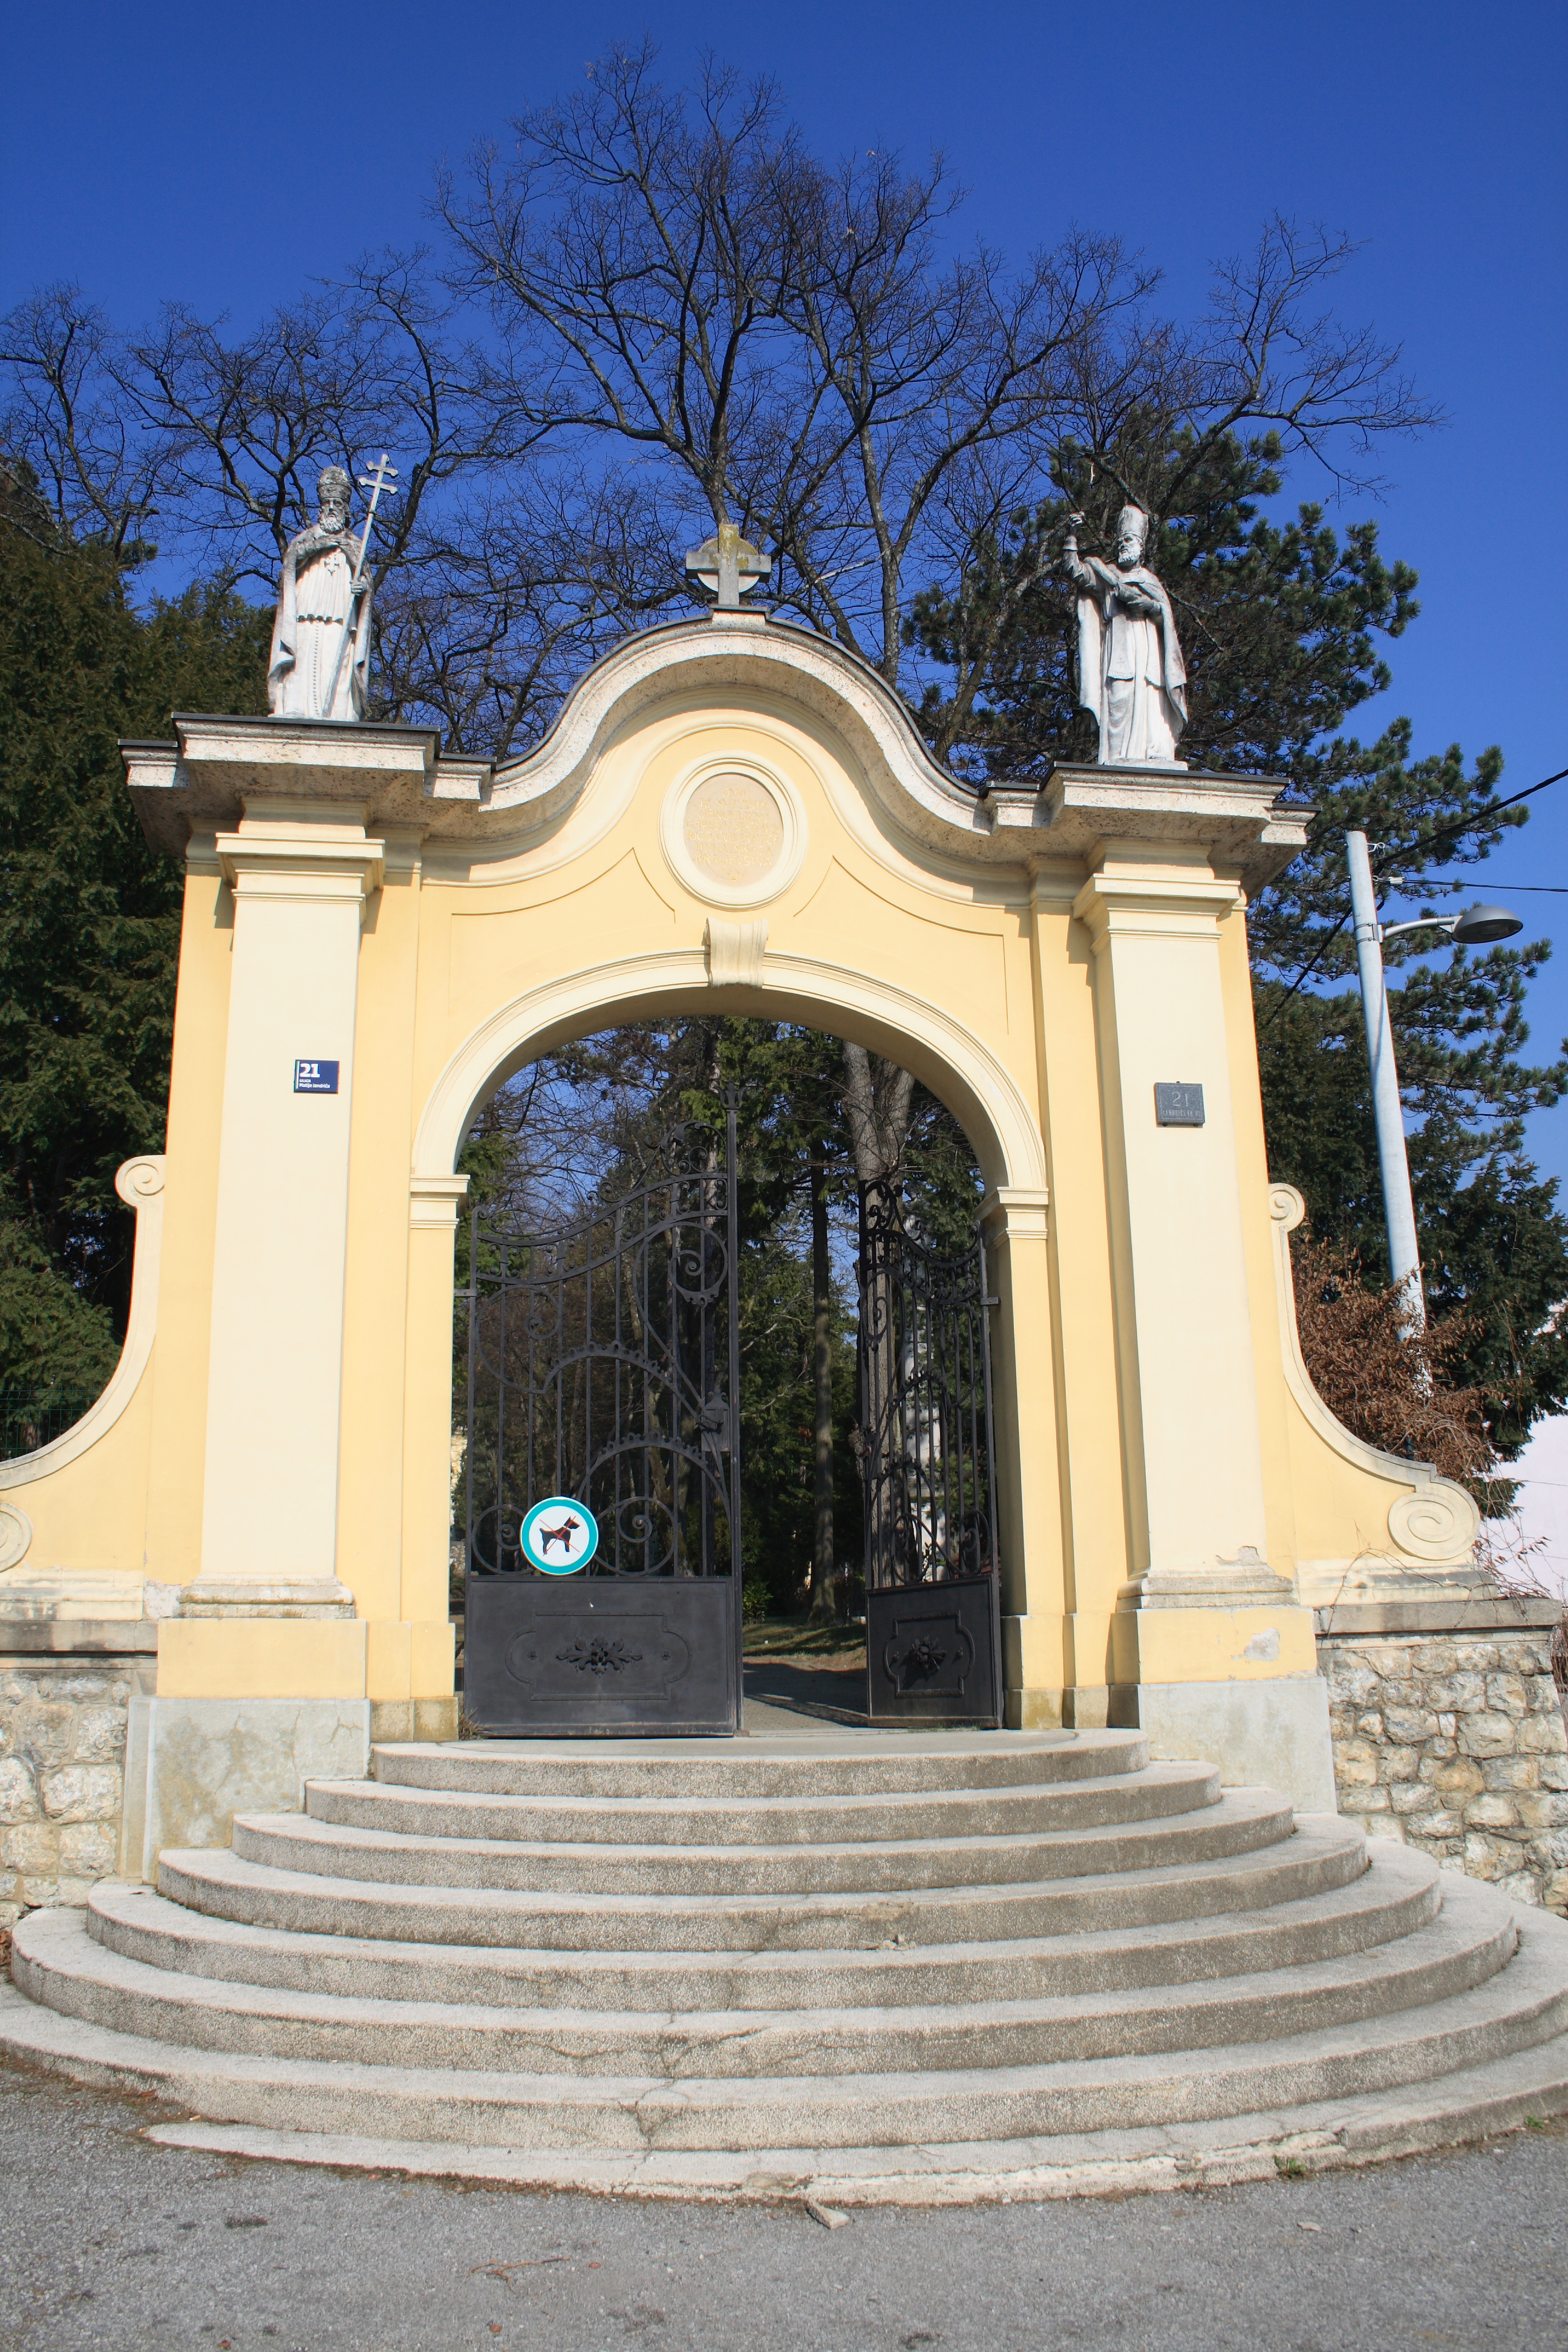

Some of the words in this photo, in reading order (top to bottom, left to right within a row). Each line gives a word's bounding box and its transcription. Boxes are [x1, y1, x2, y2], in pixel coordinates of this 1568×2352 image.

[722, 788, 745, 799] OVO
[698, 797, 711, 808] JE
[695, 842, 774, 856] HRVATSKOGA
[299, 1063, 321, 1078] 21
[1171, 1091, 1189, 1107] 21
